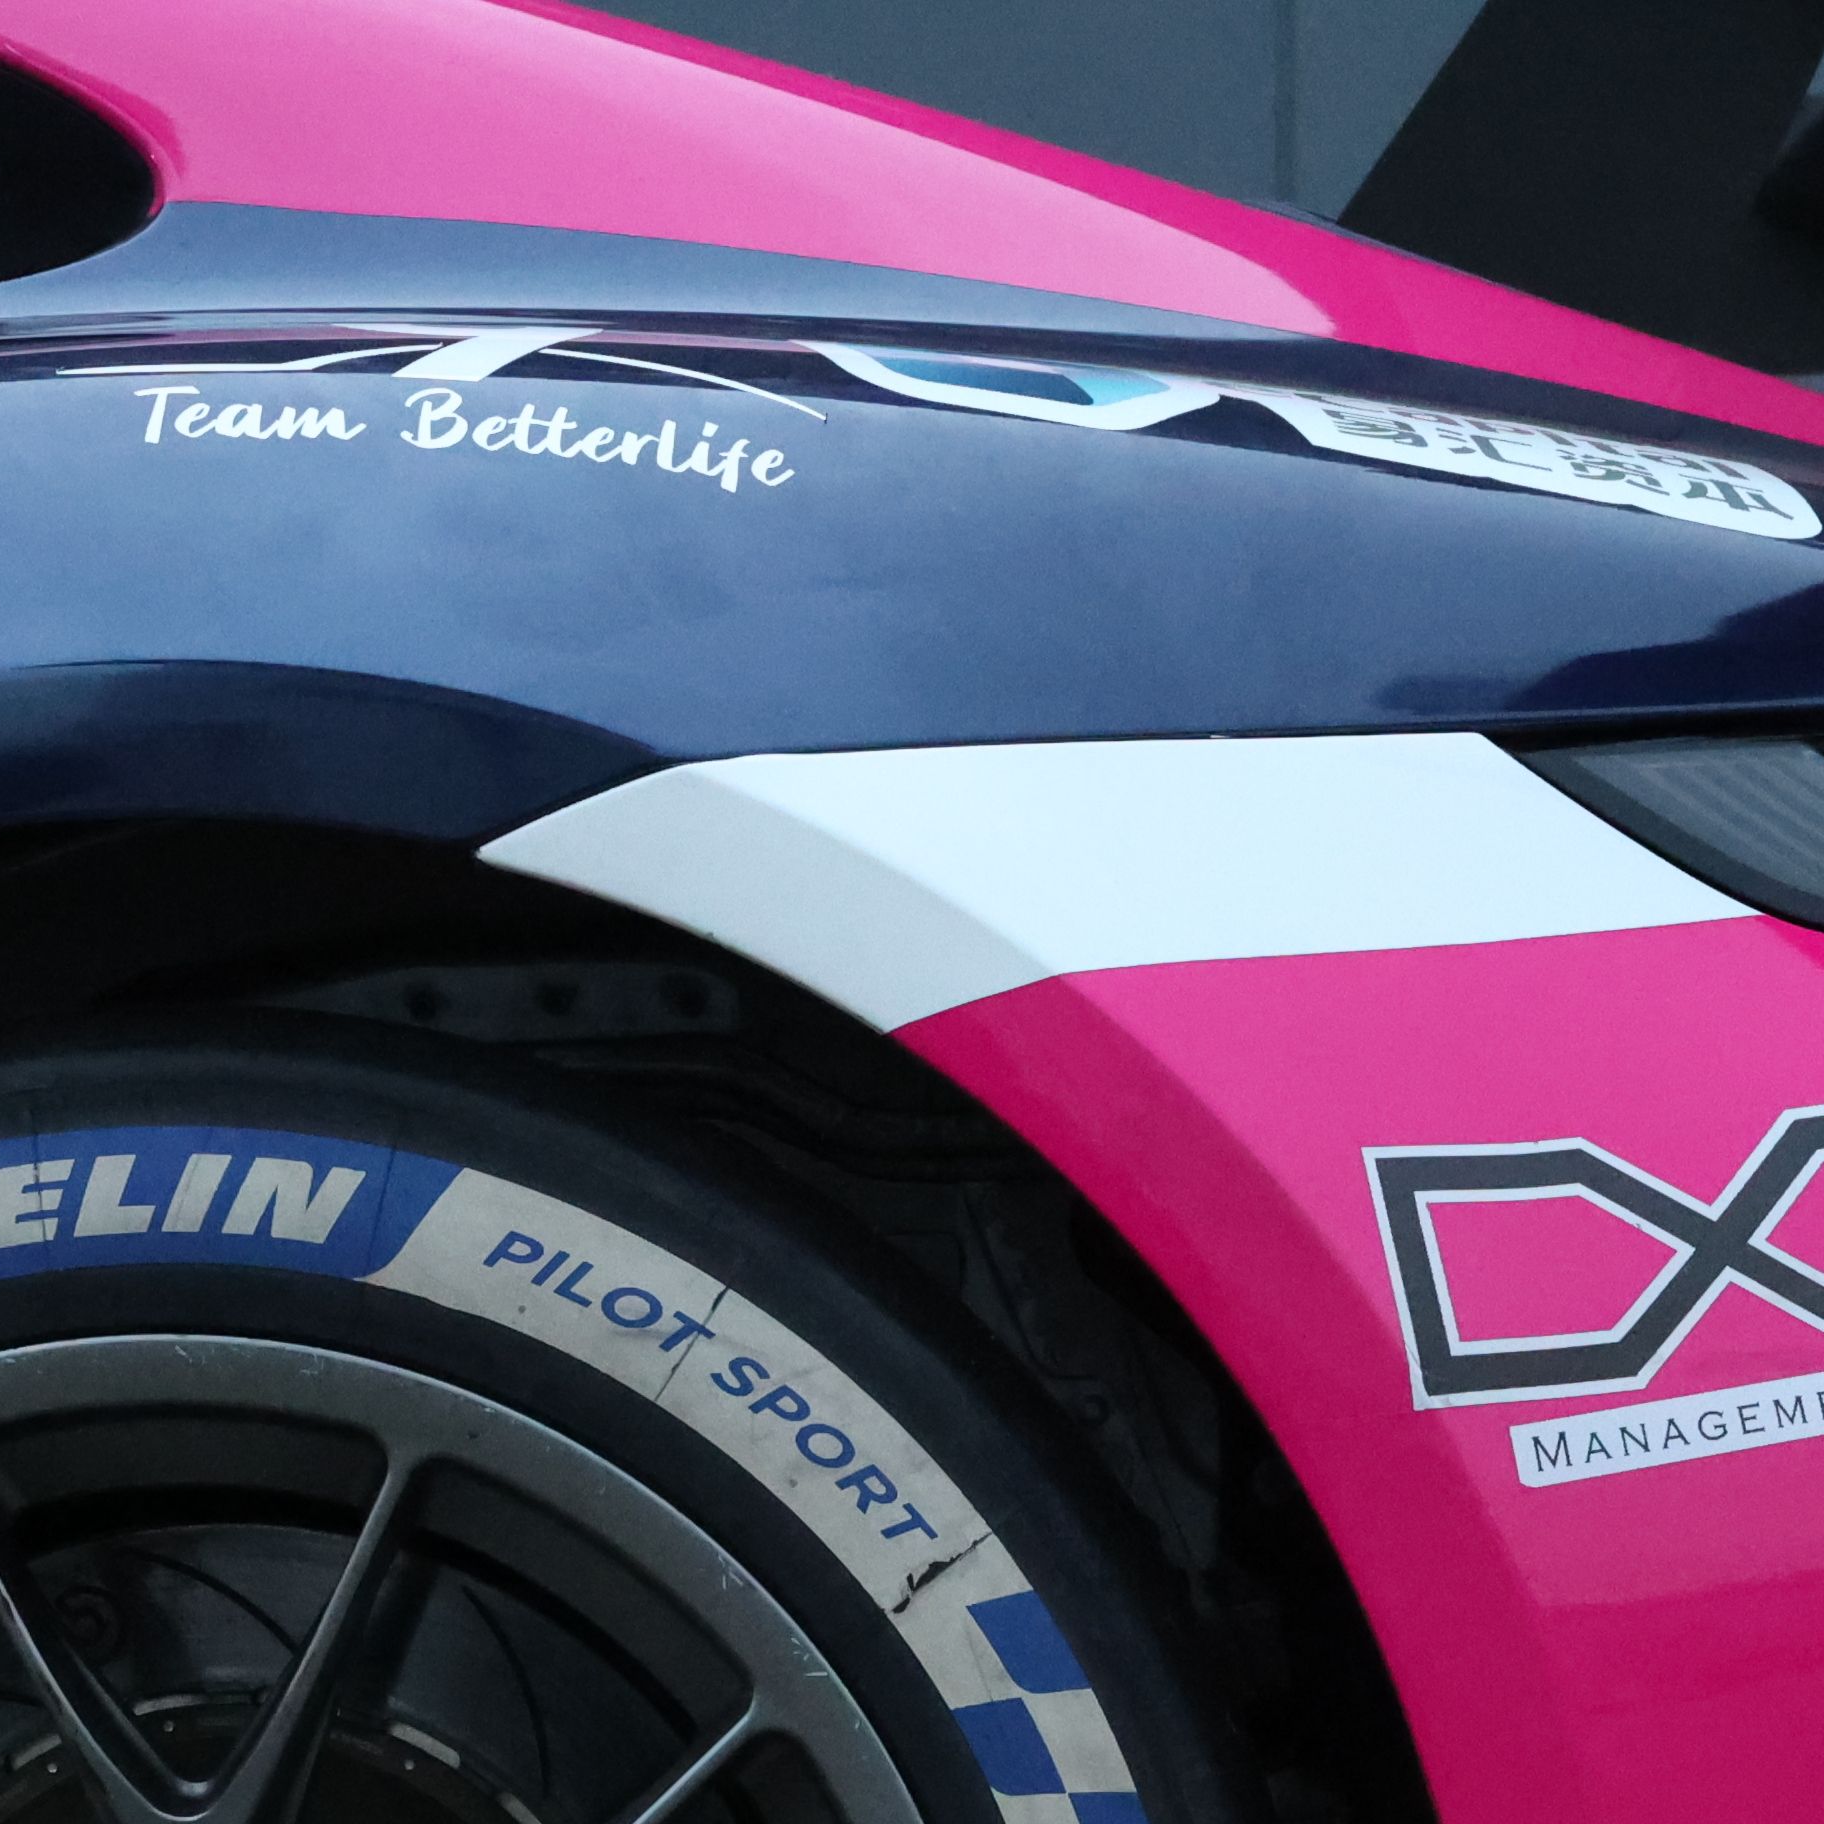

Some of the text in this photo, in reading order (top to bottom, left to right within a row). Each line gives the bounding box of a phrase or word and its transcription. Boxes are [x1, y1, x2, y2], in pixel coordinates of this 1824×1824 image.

[133, 385, 795, 493] Team Betterlife
[481, 1229, 940, 1548] PILOT SPORT
